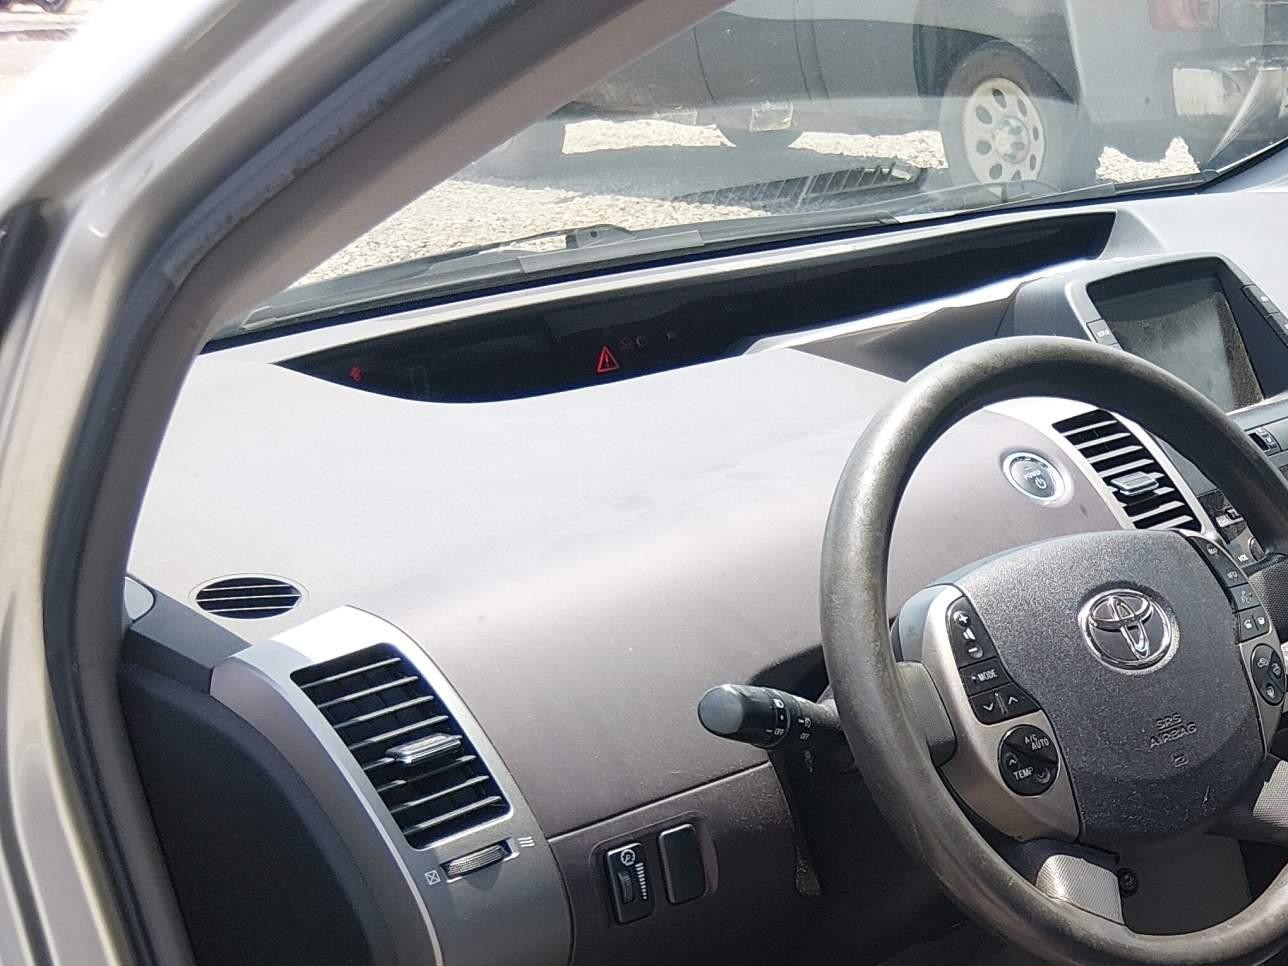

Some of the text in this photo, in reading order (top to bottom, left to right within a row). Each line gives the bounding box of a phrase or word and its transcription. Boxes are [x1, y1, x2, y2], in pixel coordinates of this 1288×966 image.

[978, 669, 998, 682] MODE
[1156, 712, 1181, 729] SRS
[774, 728, 785, 736] OFF
[1024, 733, 1038, 744] A/C
[1150, 722, 1197, 749] AIRBAG
[1031, 739, 1050, 751] AUTO
[1013, 766, 1034, 780] TEMP
